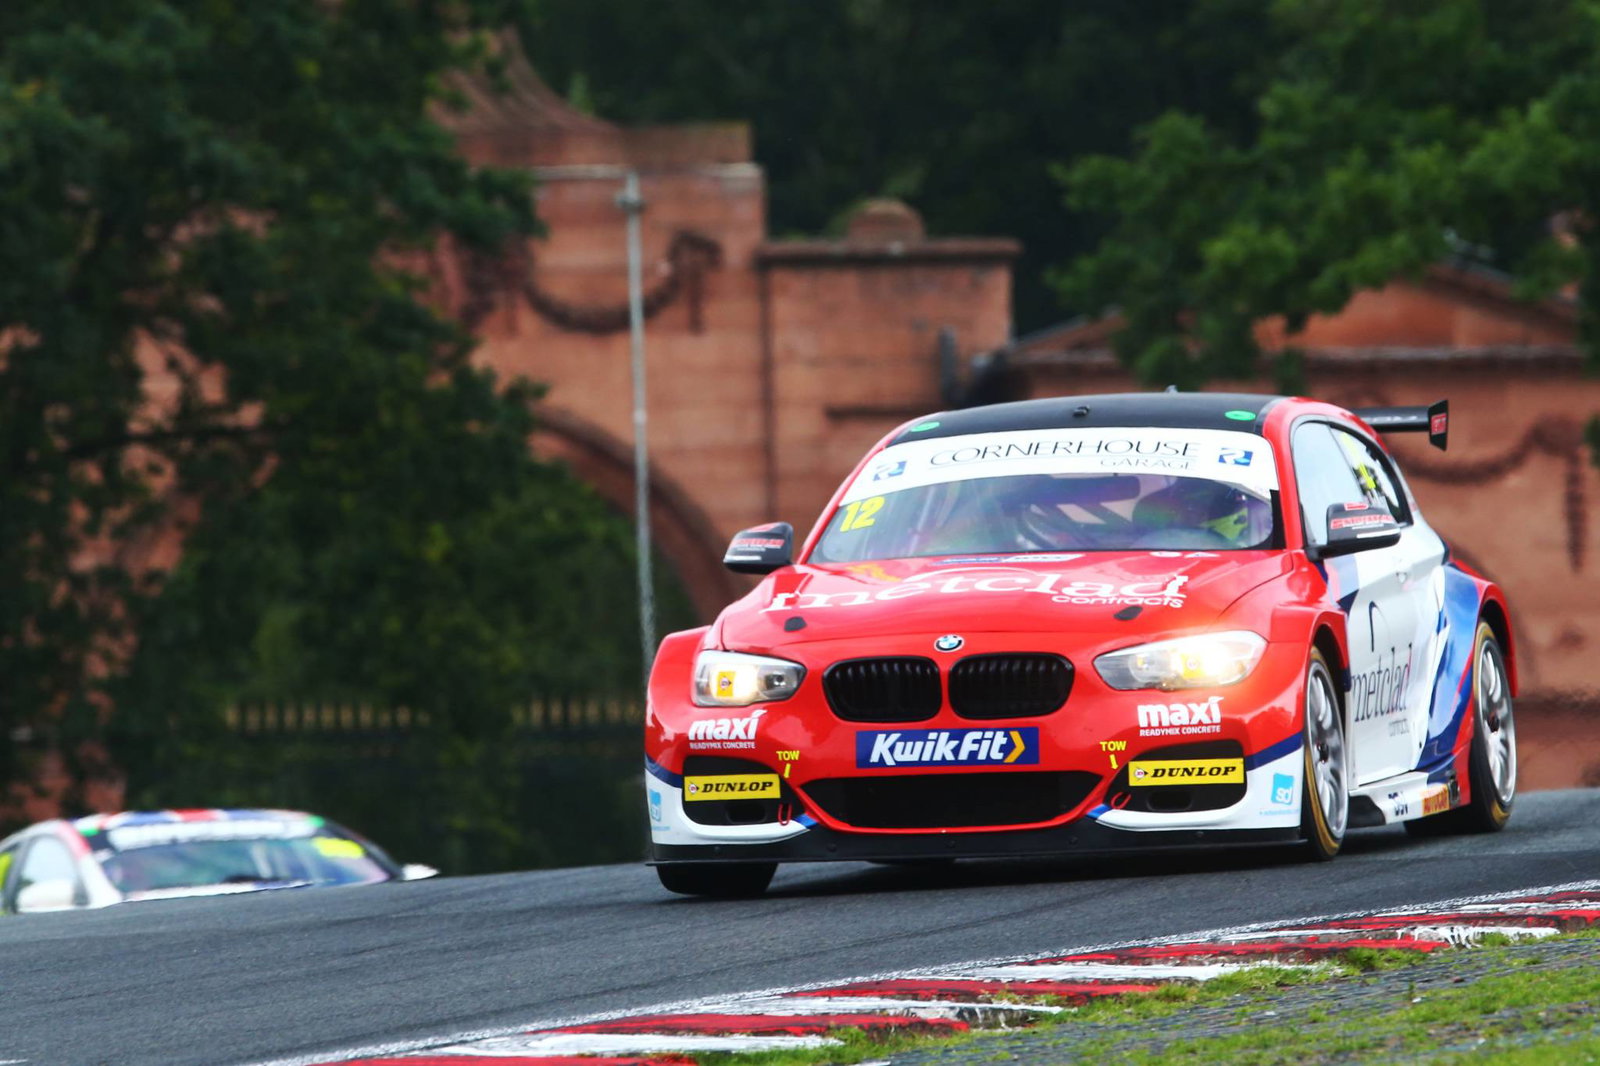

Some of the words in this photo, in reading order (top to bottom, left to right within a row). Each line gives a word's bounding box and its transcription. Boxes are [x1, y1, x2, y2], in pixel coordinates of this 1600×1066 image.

[930, 439, 1201, 466] CORNERHOUSE
[1100, 457, 1196, 471] GARAGE
[840, 496, 885, 532] 12
[765, 573, 1189, 611] metclad
[1051, 593, 1184, 609] contracts
[1351, 643, 1412, 722] metclad
[1139, 727, 1180, 737] READYMIX
[1181, 725, 1221, 735] CONCRETE
[689, 742, 721, 750] READYMIX
[722, 741, 756, 749] CONCRETE
[1100, 741, 1126, 752] TOW
[776, 751, 800, 762] TOW
[1151, 766, 1236, 778] DUNLOP
[701, 781, 773, 793] DUNLOP
